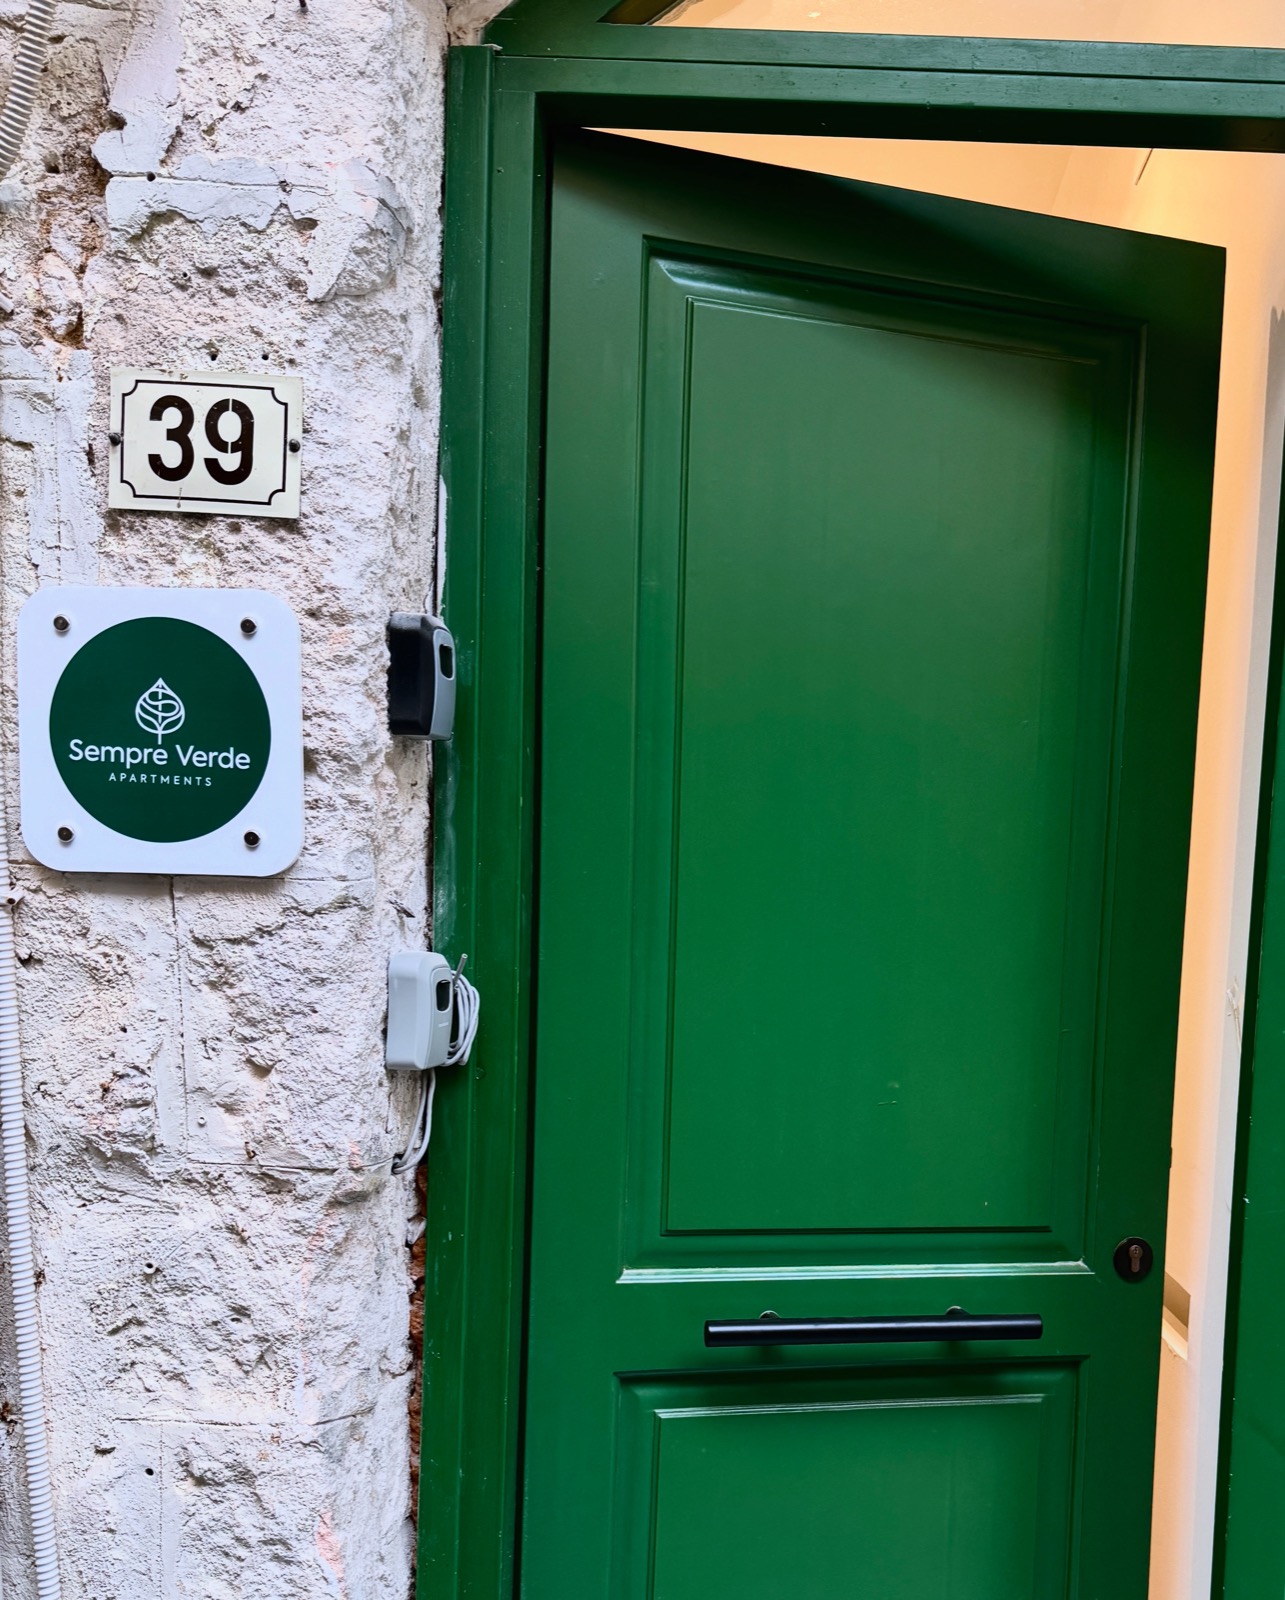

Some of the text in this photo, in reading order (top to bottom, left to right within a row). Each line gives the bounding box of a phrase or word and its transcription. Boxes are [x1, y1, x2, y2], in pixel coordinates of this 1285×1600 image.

[147, 394, 254, 486] 39
[68, 738, 251, 770] Sempre Verde
[108, 772, 213, 787] APARTMENTS
